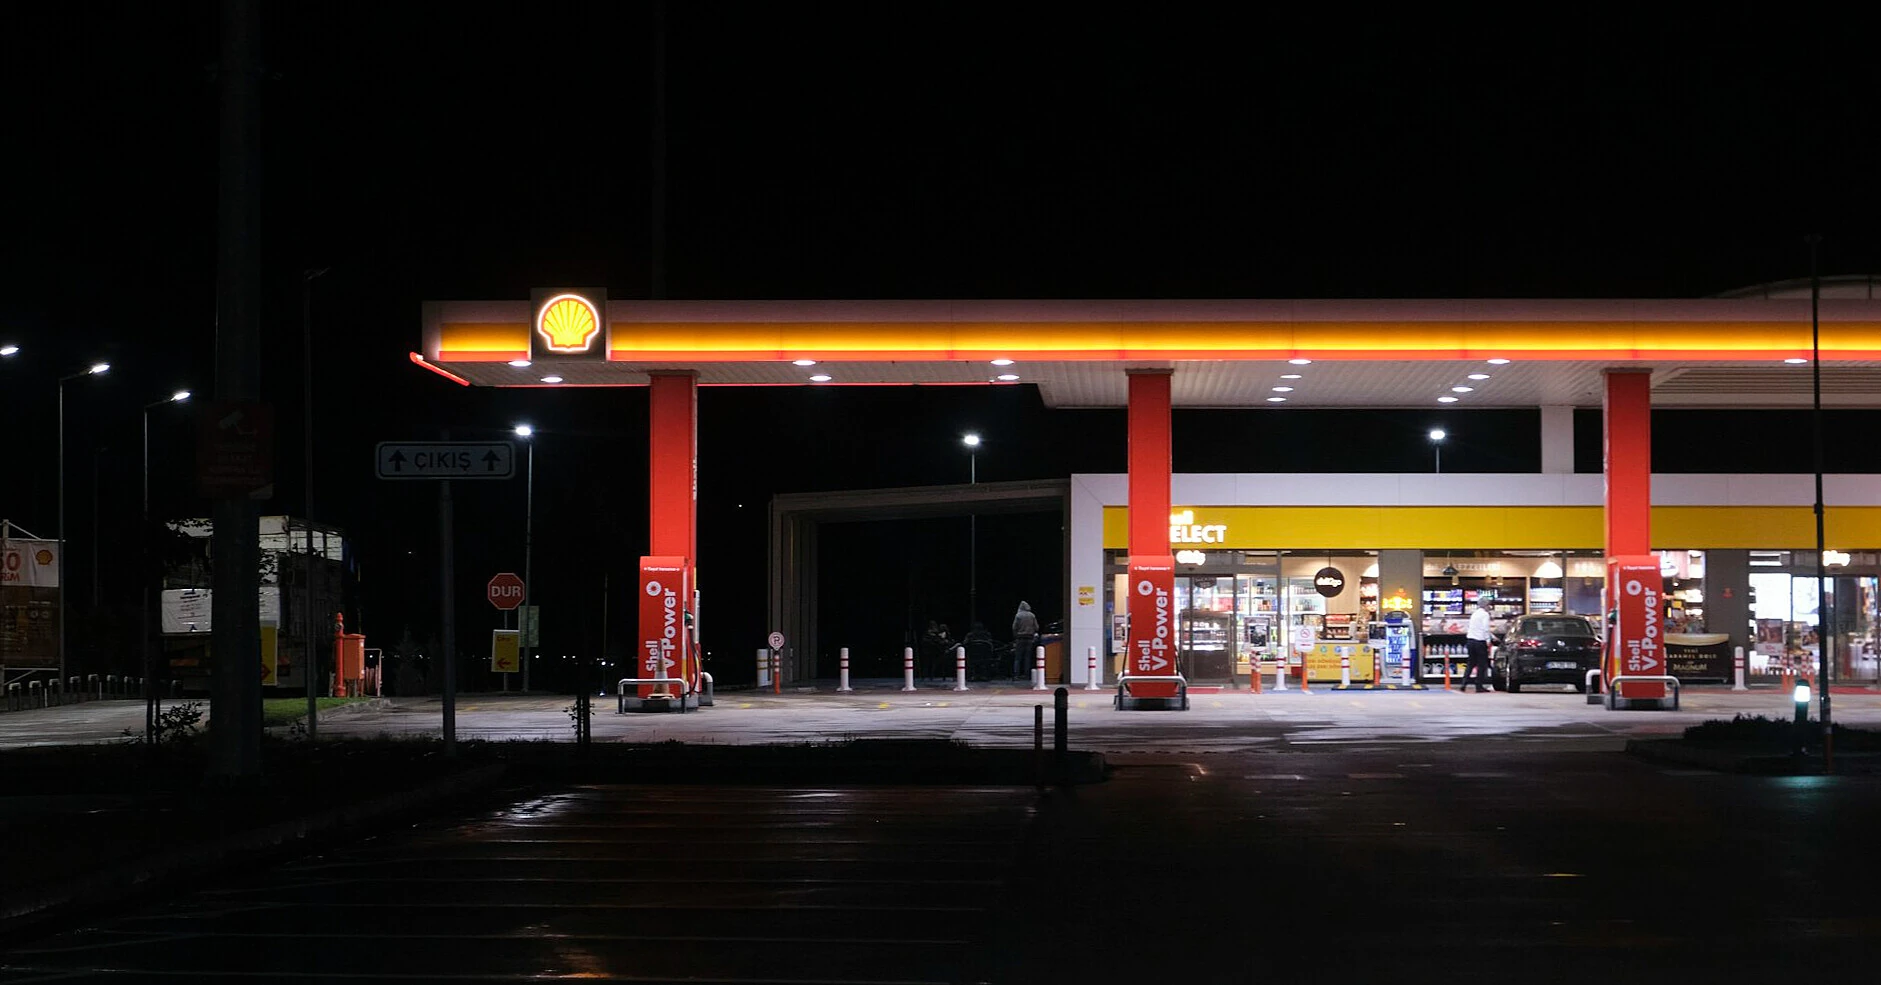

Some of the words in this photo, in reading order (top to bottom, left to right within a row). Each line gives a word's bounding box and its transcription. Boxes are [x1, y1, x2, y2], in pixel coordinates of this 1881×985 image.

[414, 452, 471, 471] ÇIKIŞ
[1170, 525, 1227, 543] ELECT
[491, 586, 521, 597] DUR
[660, 588, 676, 669] V-Power
[1152, 587, 1168, 671] V-Power
[1641, 587, 1657, 671] V-Power
[645, 640, 658, 672] Shell
[1138, 640, 1151, 671] Shell
[1628, 640, 1640, 671] Shell
